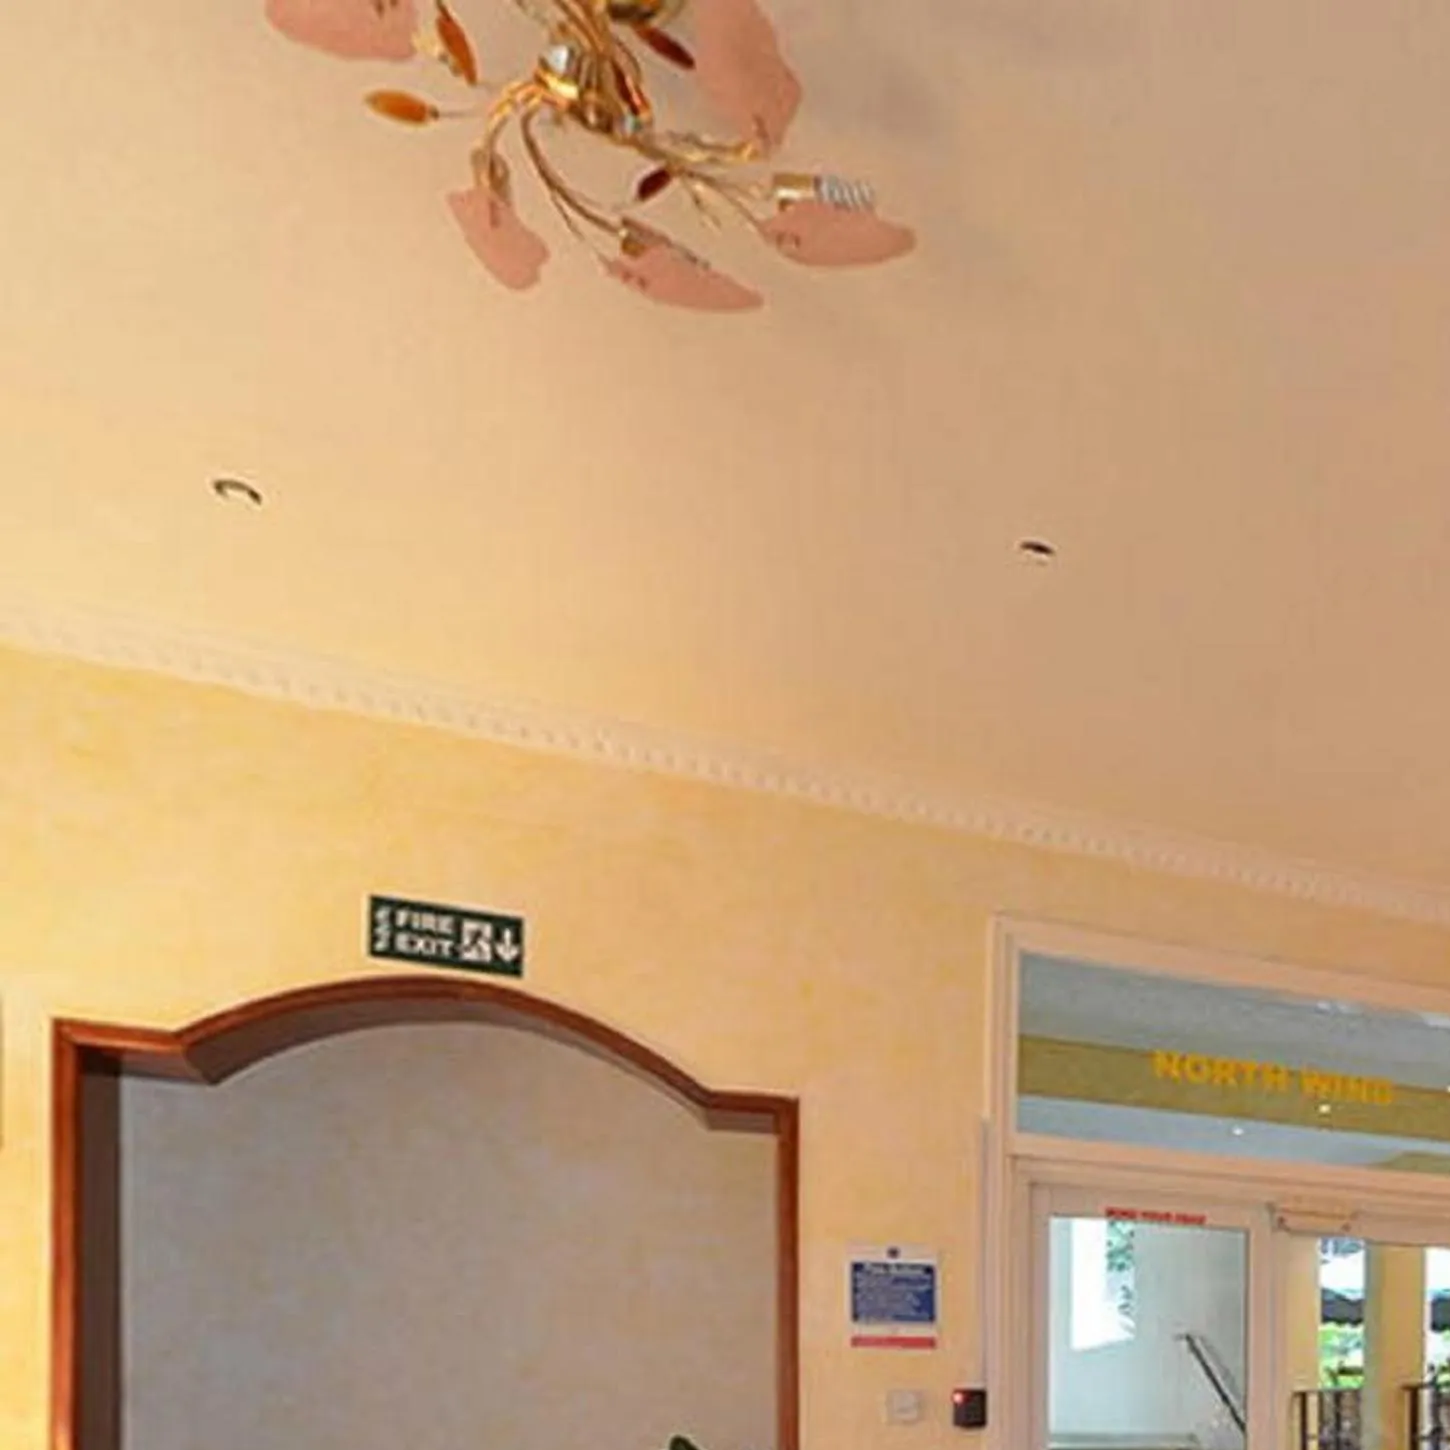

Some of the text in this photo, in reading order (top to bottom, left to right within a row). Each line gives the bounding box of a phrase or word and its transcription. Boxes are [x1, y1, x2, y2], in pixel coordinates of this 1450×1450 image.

[395, 907, 454, 934] FIRE
[395, 931, 454, 957] EXIT
[1153, 1050, 1289, 1091] NORTH
